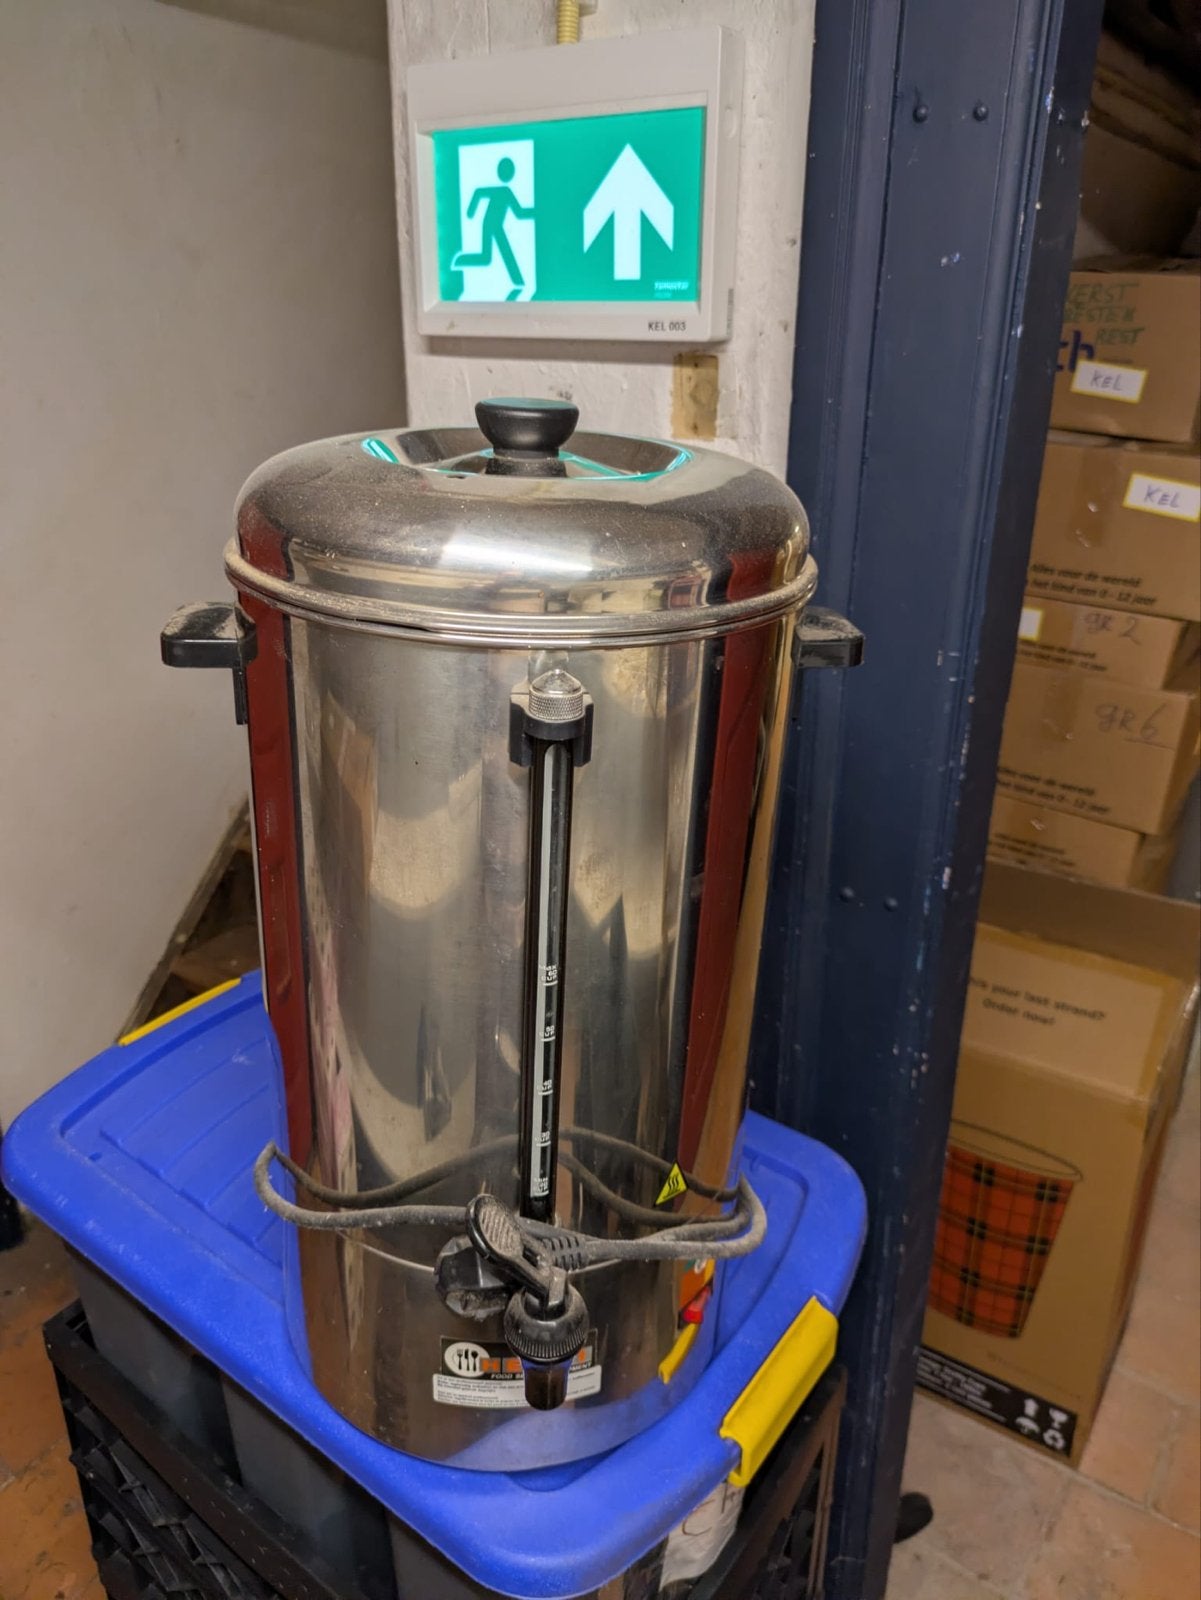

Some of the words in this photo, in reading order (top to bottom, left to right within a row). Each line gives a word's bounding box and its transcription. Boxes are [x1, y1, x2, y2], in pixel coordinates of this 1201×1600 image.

[648, 321, 666, 331] KEL
[668, 321, 687, 331] 003
[1090, 370, 1123, 392] KEL
[1144, 485, 1180, 509] KEL
